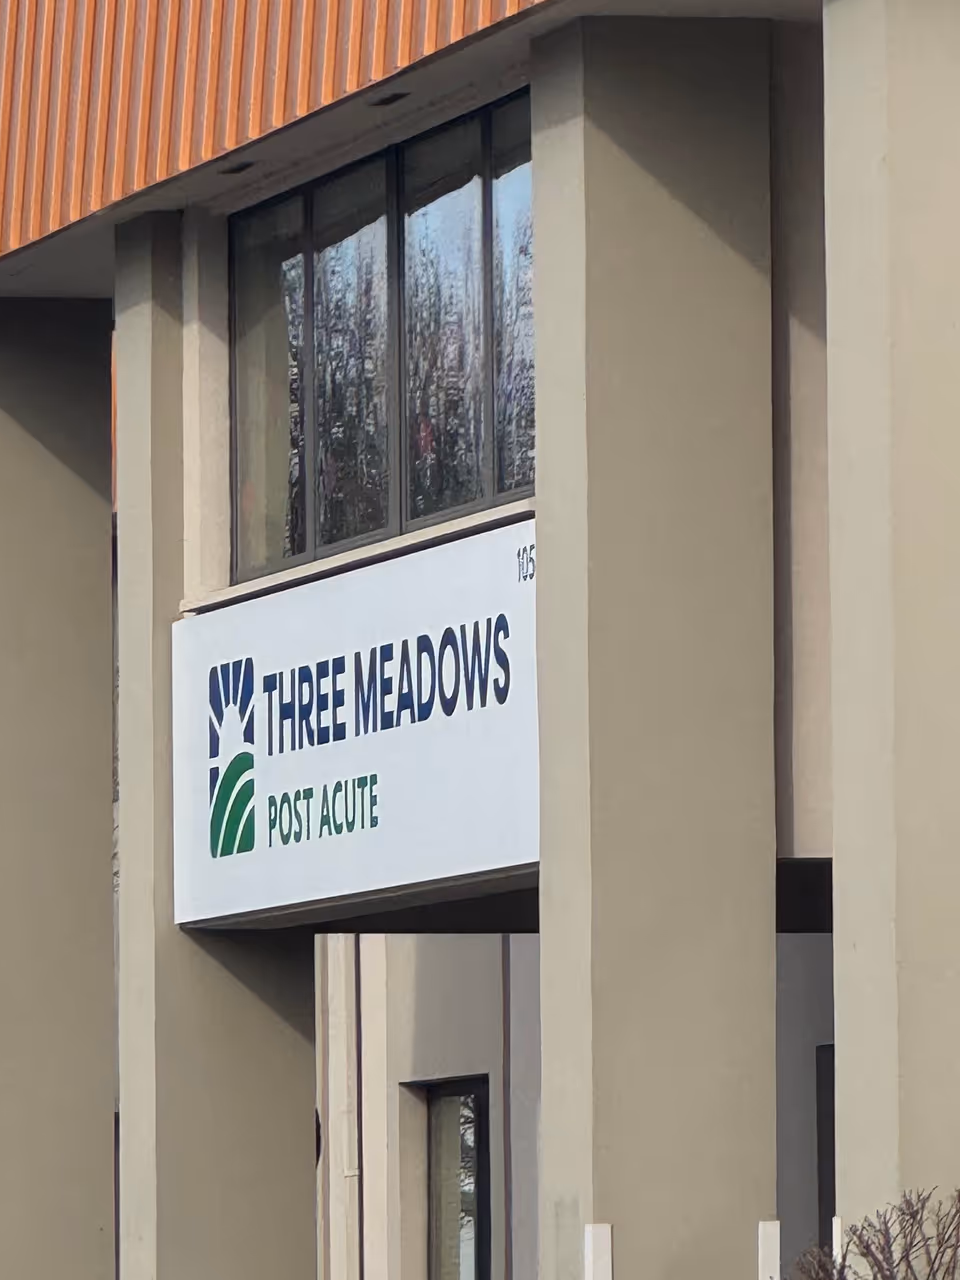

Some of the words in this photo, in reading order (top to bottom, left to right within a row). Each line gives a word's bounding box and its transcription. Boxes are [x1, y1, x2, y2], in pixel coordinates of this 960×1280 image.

[263, 655, 346, 756] THREE
[354, 613, 511, 737] MEADOWS
[268, 787, 314, 848] POST
[319, 773, 379, 838] ACUTE
